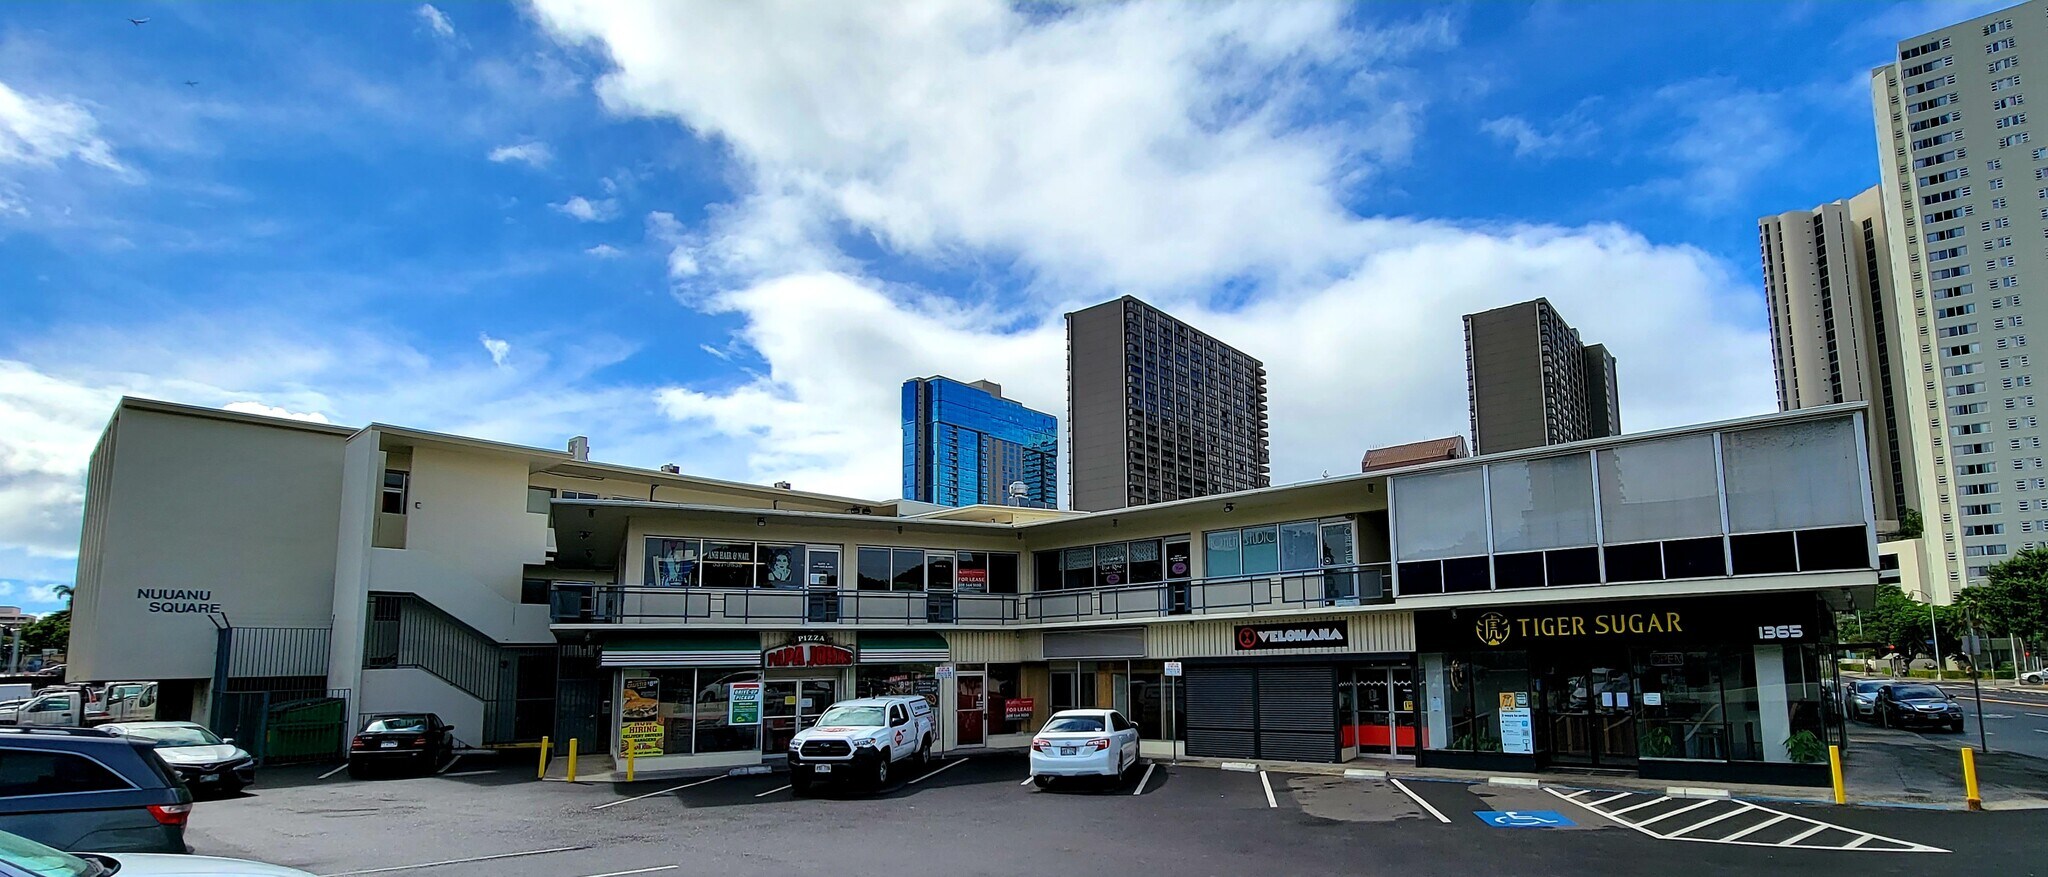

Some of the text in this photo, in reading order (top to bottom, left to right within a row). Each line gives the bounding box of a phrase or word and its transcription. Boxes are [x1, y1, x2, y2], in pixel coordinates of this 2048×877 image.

[719, 551, 732, 560] HAIR
[738, 552, 750, 561] NAIL
[137, 588, 211, 601] NUUANU
[149, 602, 221, 613] SQUARE
[1517, 612, 1683, 637] TIGER SUGAR
[798, 634, 825, 642] PIZZA
[1257, 627, 1344, 643] VELOHANA
[1758, 624, 1804, 639] 1365
[767, 646, 806, 667] PAPA
[629, 726, 657, 734] HIRING
